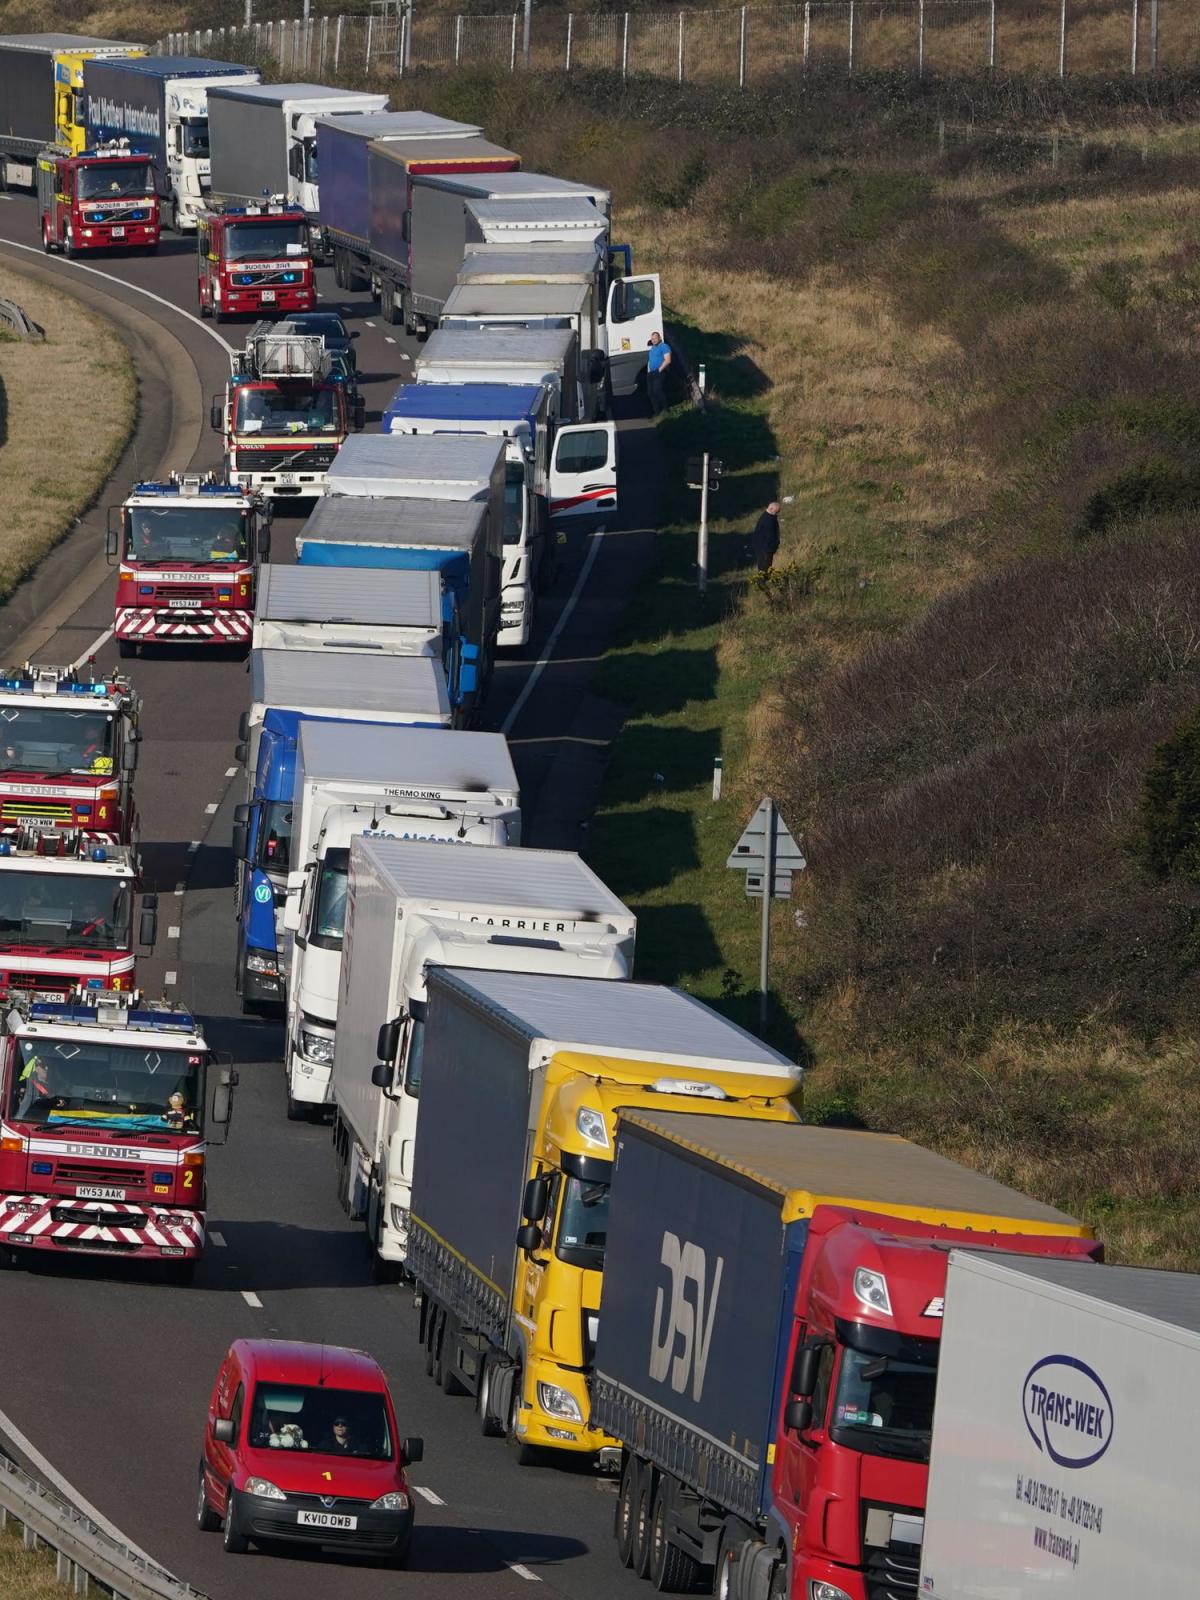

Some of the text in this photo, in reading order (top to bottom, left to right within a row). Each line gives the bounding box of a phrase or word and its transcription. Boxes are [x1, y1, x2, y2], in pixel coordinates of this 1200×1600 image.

[161, 573, 210, 581] DENNIS
[240, 584, 247, 596] 5
[9, 785, 66, 796] DENNIS
[384, 788, 441, 799] THERMO KING
[99, 806, 107, 819] 4
[470, 916, 565, 932] CARRIER
[112, 978, 121, 992] 3
[66, 1143, 141, 1159] DENNIS
[183, 1170, 193, 1188] 2
[79, 1187, 122, 1199] HY53 AAK
[648, 1231, 724, 1403] DSV
[1031, 1383, 1105, 1440] TRANS-WEK
[304, 1512, 352, 1527] KV10 OWB
